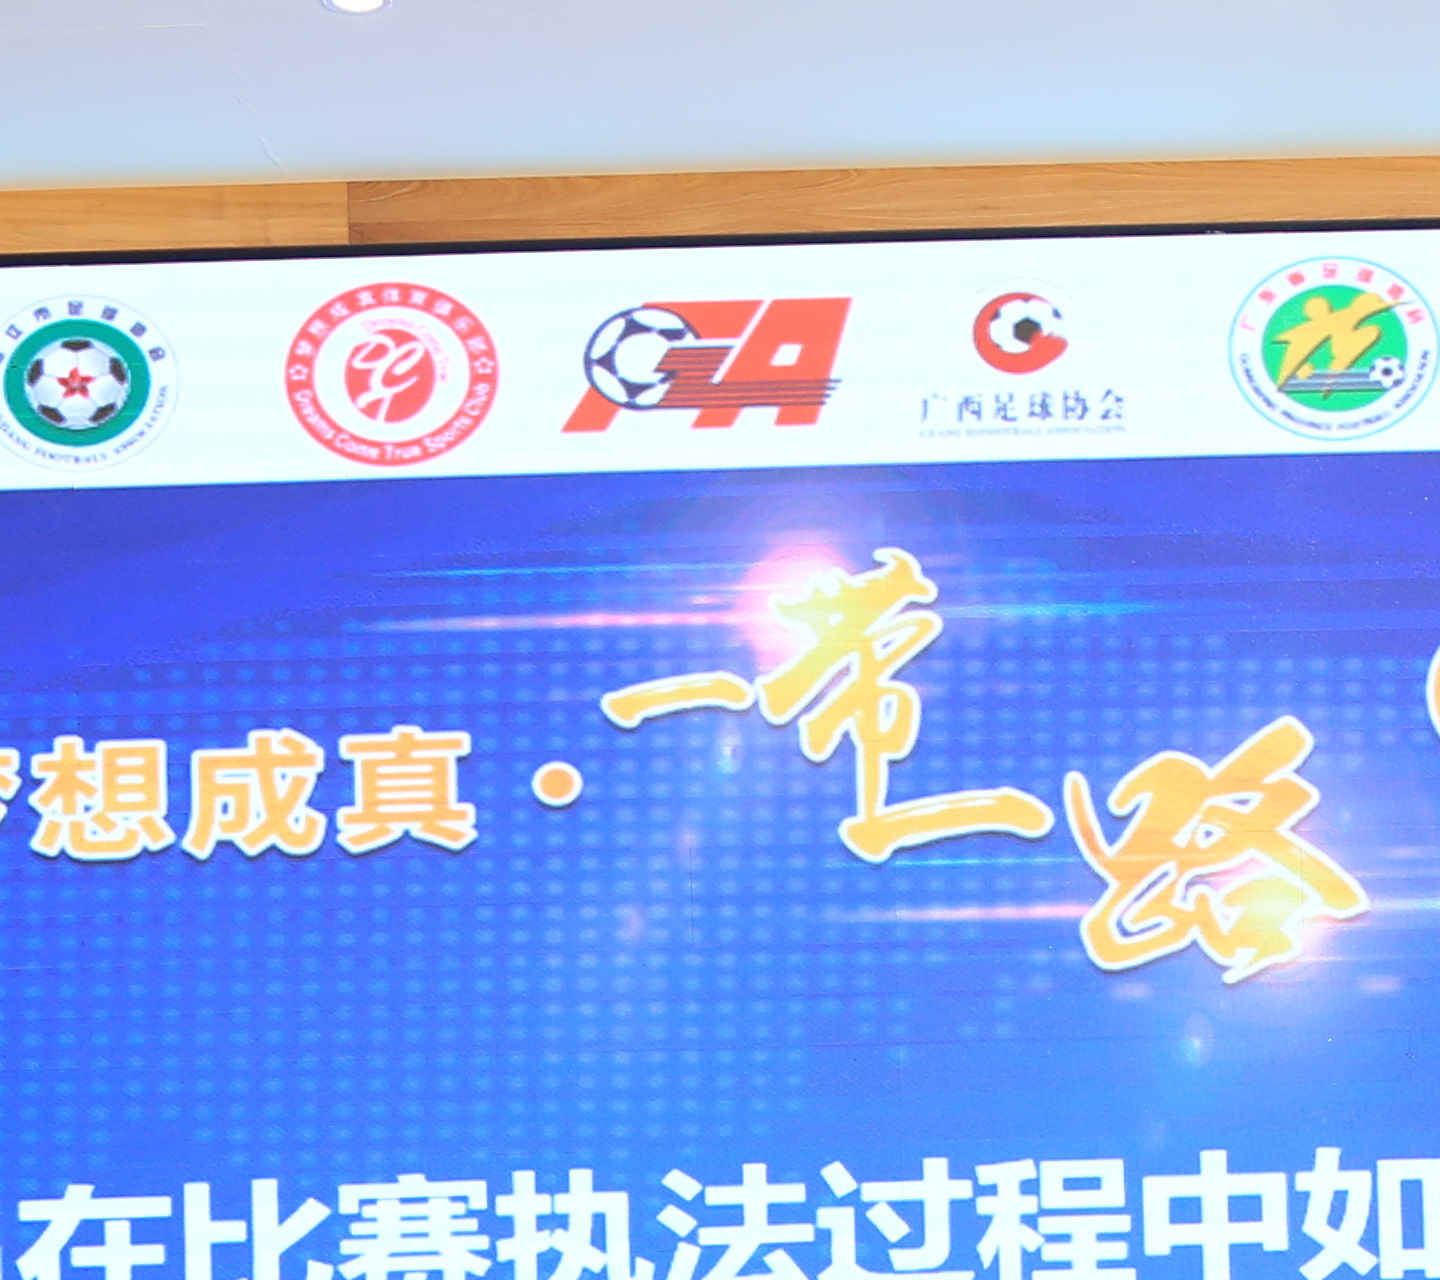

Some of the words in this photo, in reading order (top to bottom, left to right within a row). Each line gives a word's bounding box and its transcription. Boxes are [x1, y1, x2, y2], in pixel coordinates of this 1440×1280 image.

[920, 388, 1126, 422] 广西足球协会
